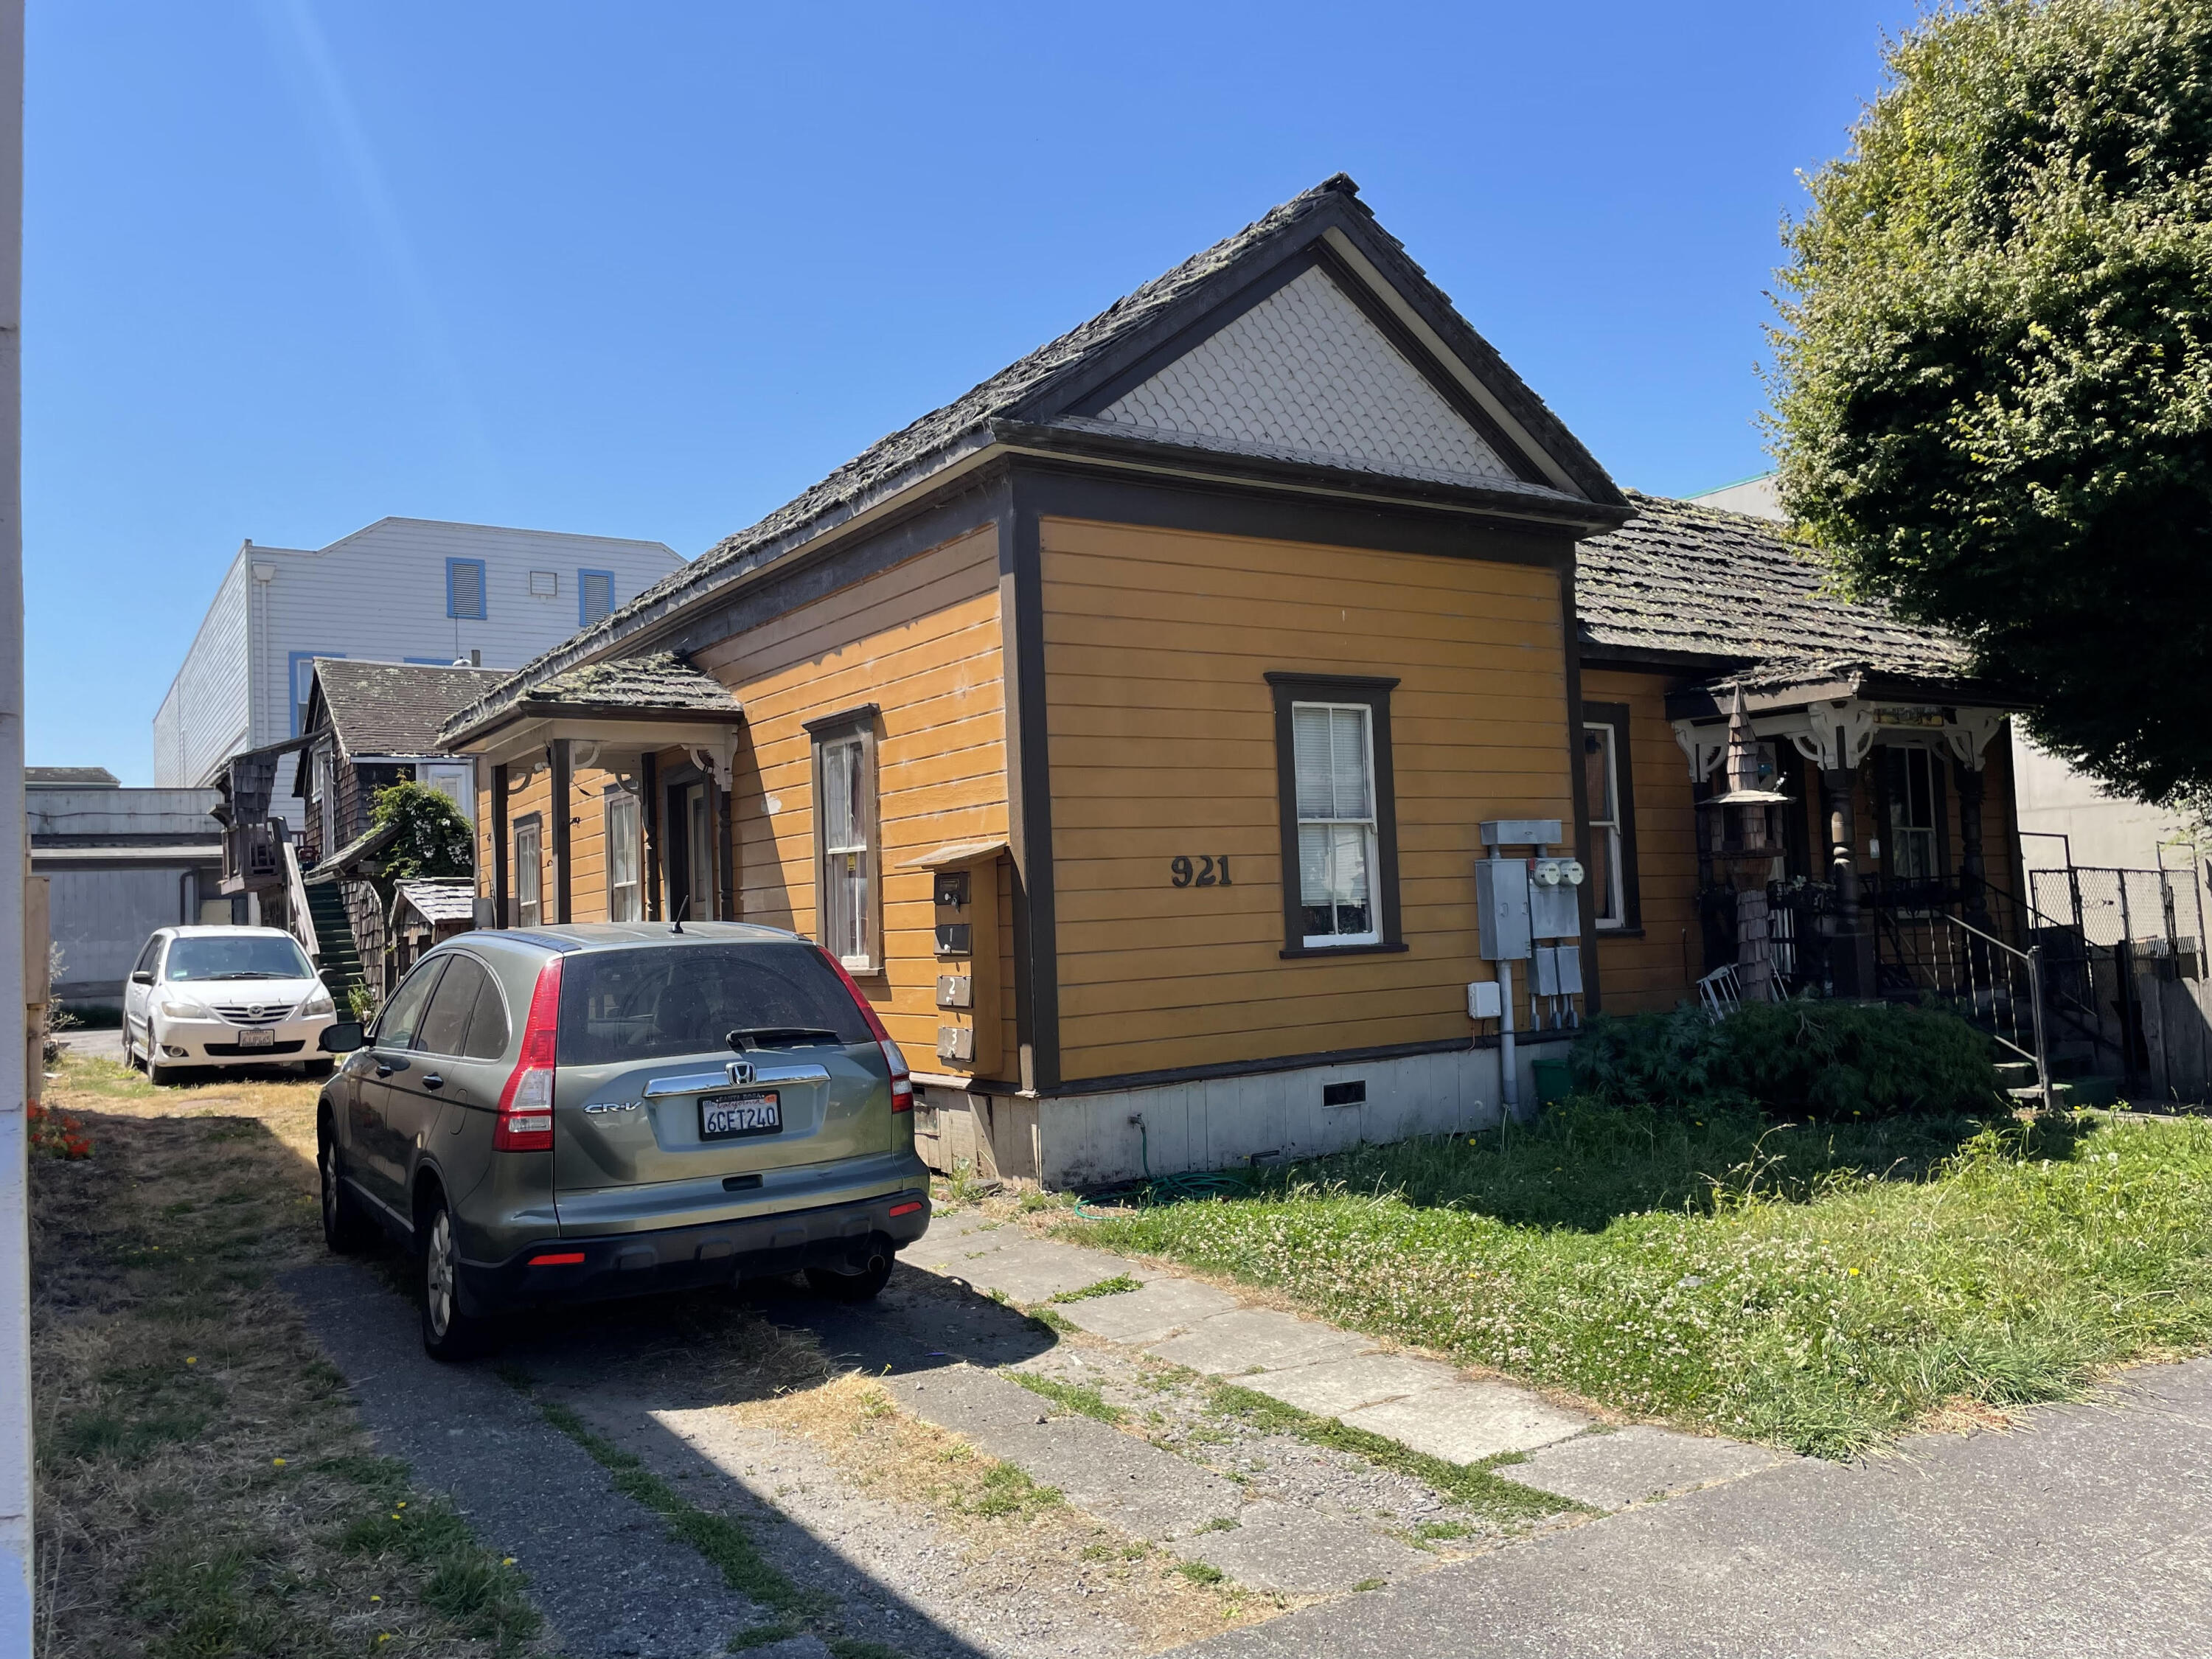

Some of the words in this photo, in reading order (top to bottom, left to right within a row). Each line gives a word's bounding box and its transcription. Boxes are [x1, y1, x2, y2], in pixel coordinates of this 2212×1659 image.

[1171, 855, 1232, 888] 921
[949, 977, 956, 995] 2
[952, 1028, 957, 1045] 3
[584, 1102, 642, 1113] CR-V
[708, 1106, 776, 1132] 6CET240
